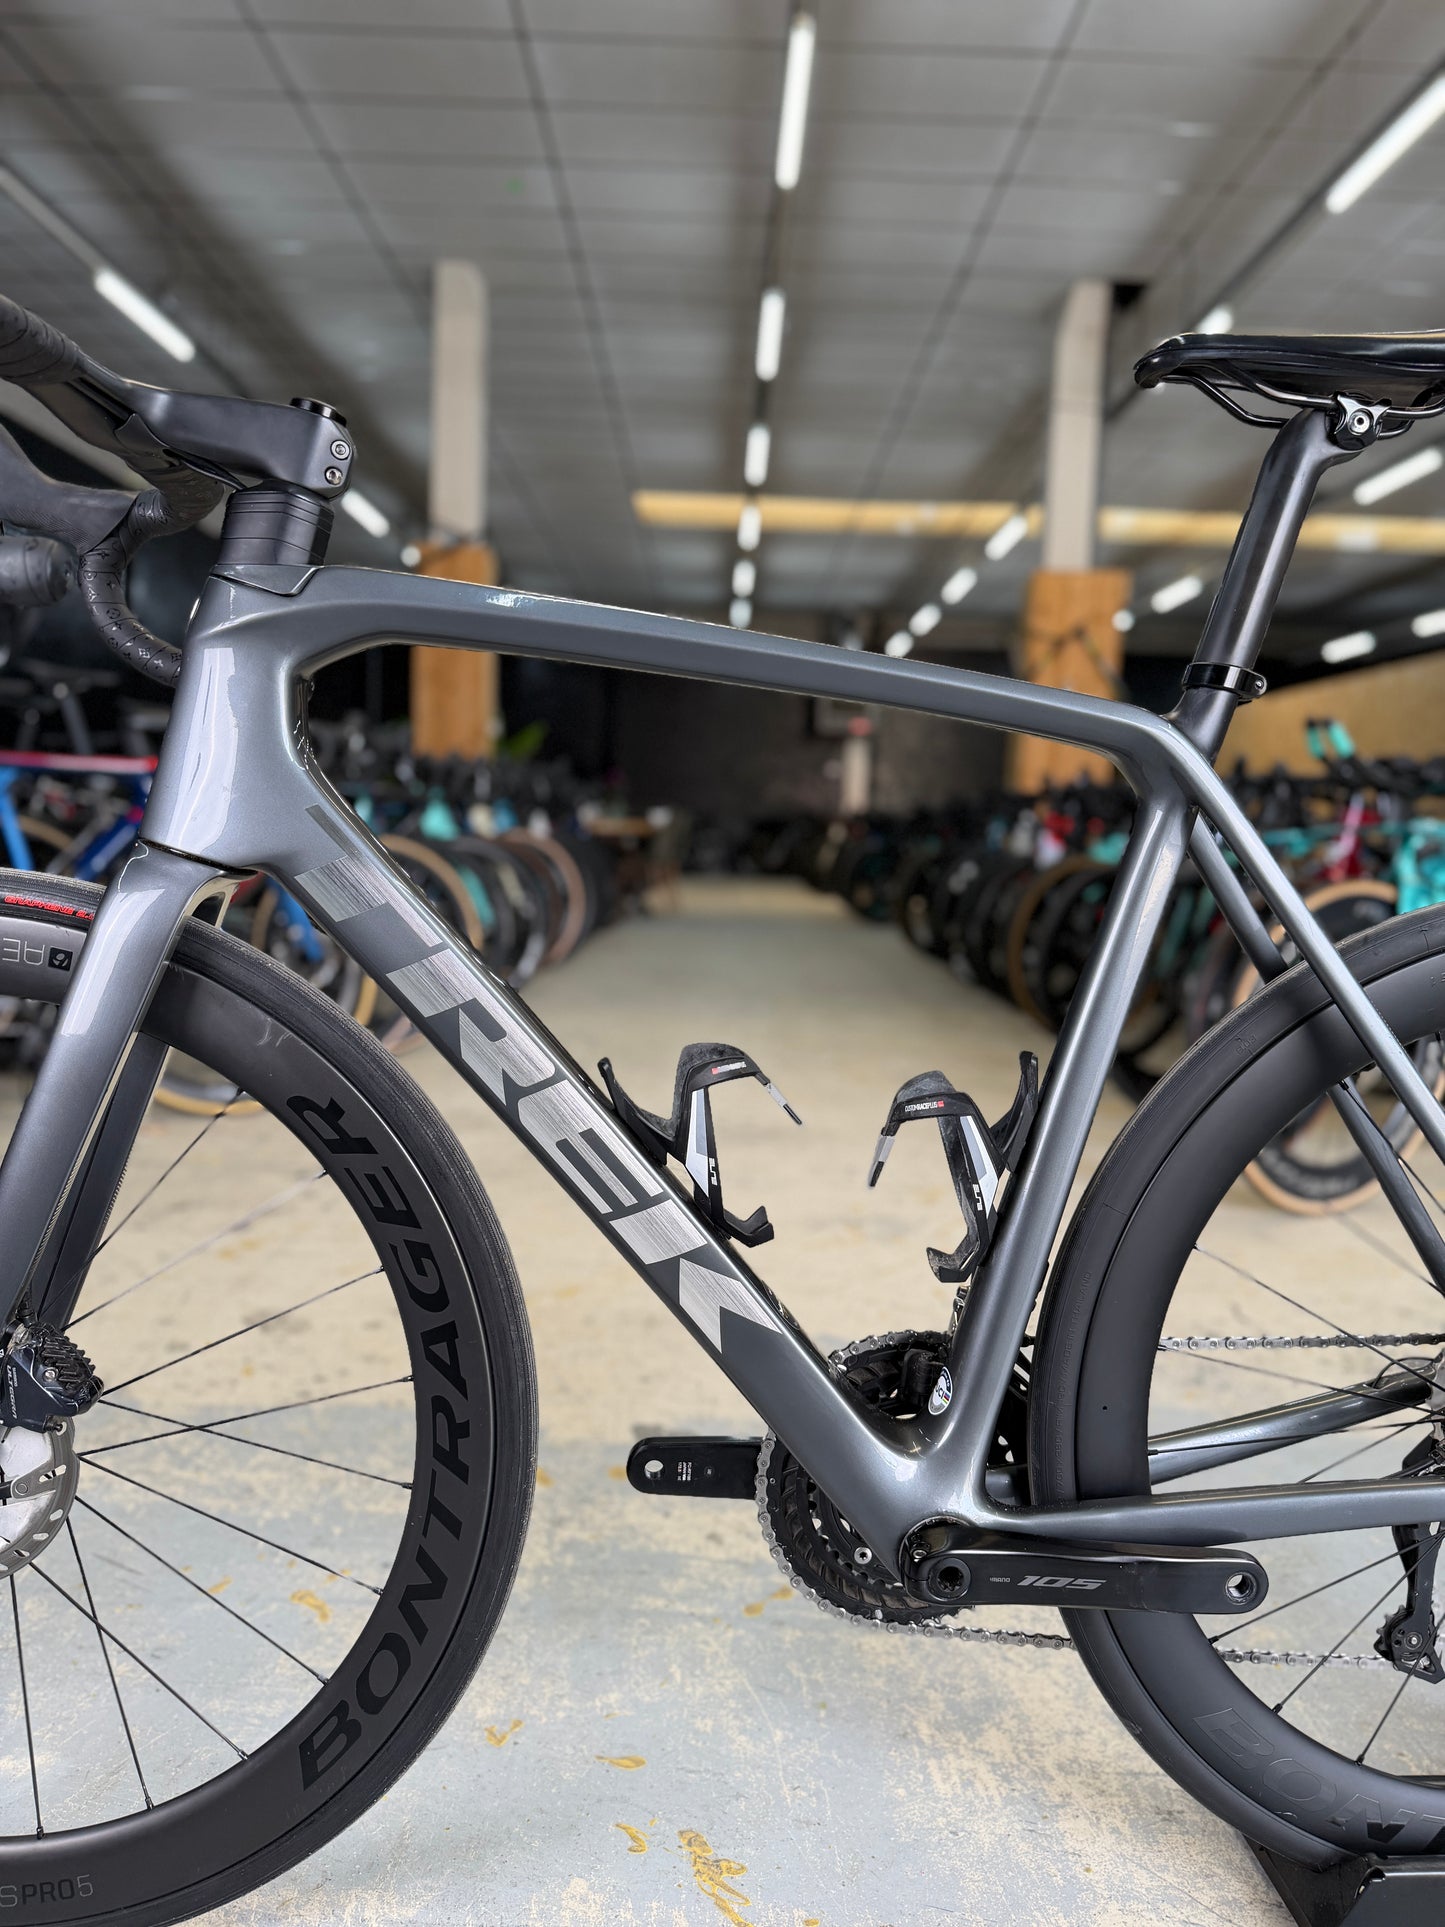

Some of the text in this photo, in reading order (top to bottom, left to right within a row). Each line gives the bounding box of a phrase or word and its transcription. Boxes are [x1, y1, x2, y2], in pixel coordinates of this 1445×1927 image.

[293, 804, 783, 1353] TREK
[7, 1365, 18, 1420] ULTEGRA
[285, 1093, 471, 1790] BONTRAGER
[1017, 1575, 1107, 1590] 105
